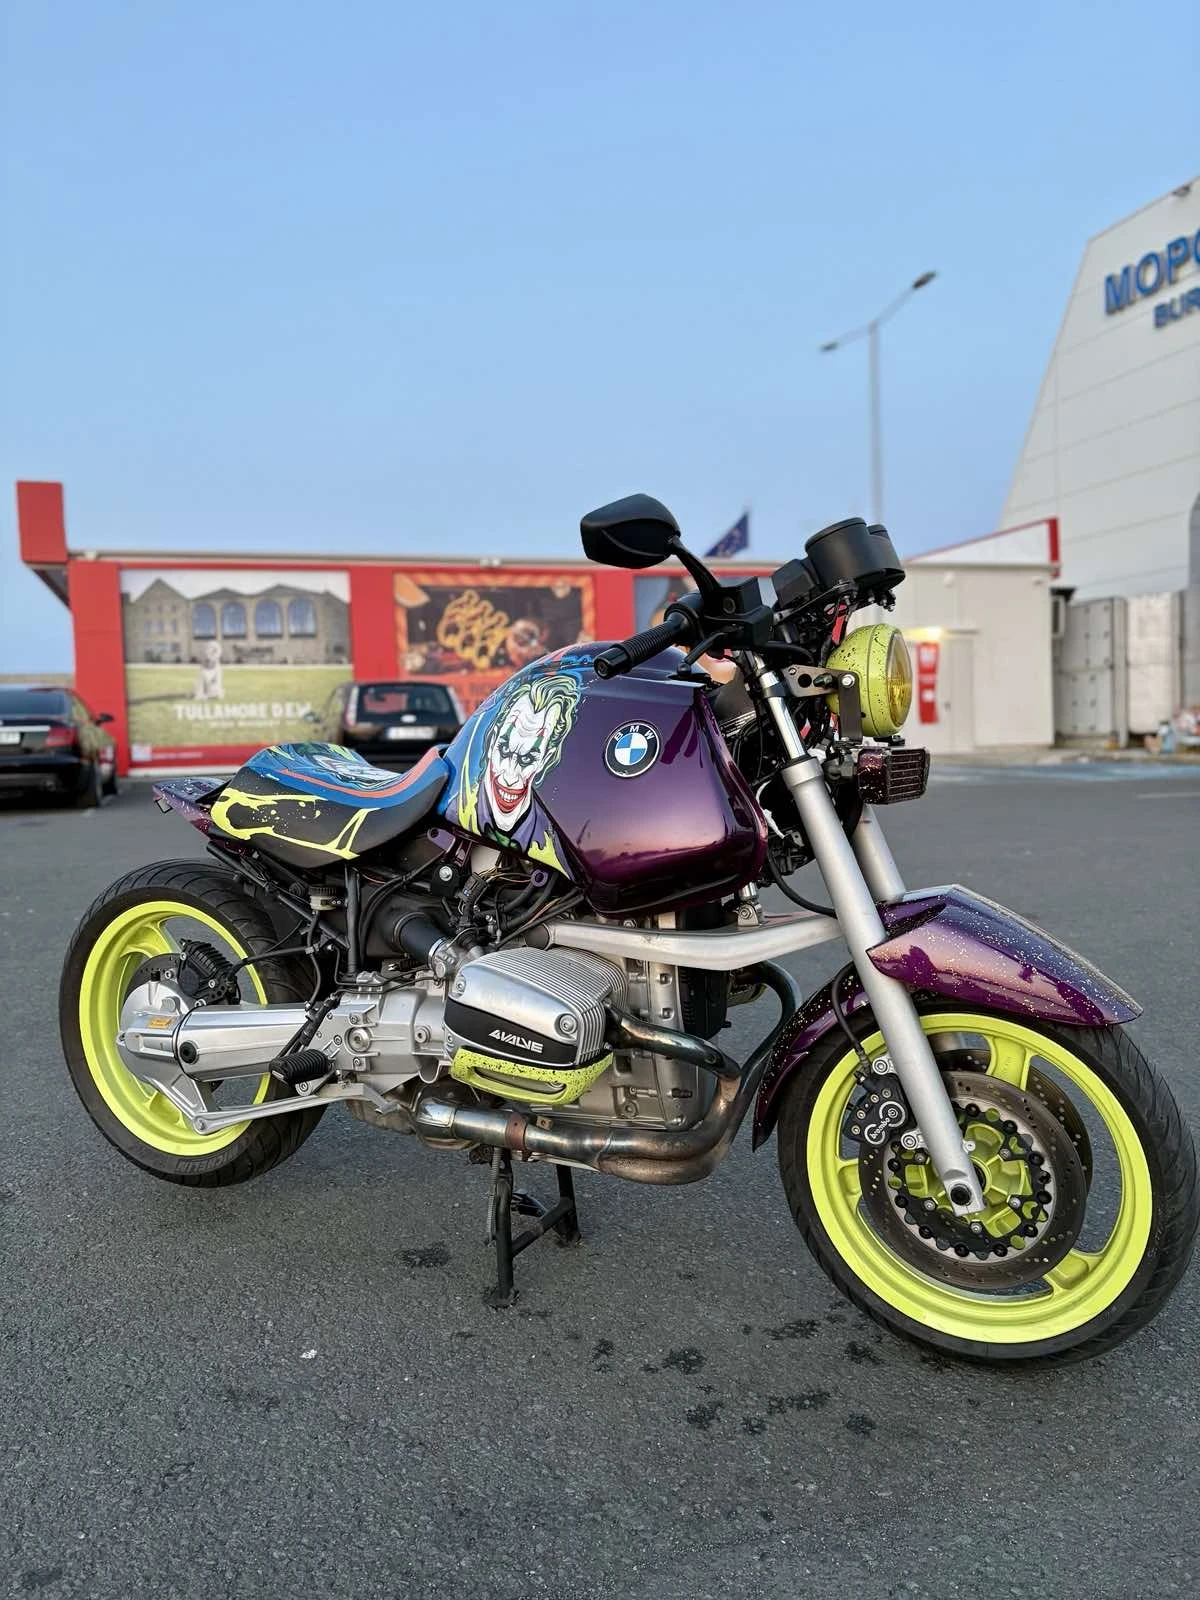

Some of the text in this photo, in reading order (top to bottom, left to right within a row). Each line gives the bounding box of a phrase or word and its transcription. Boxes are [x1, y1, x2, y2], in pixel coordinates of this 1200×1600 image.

[174, 703, 268, 720] TULLAMORE
[613, 725, 655, 741] BMW
[488, 1029, 544, 1054] 4VALVE
[869, 1117, 891, 1140] brembo
